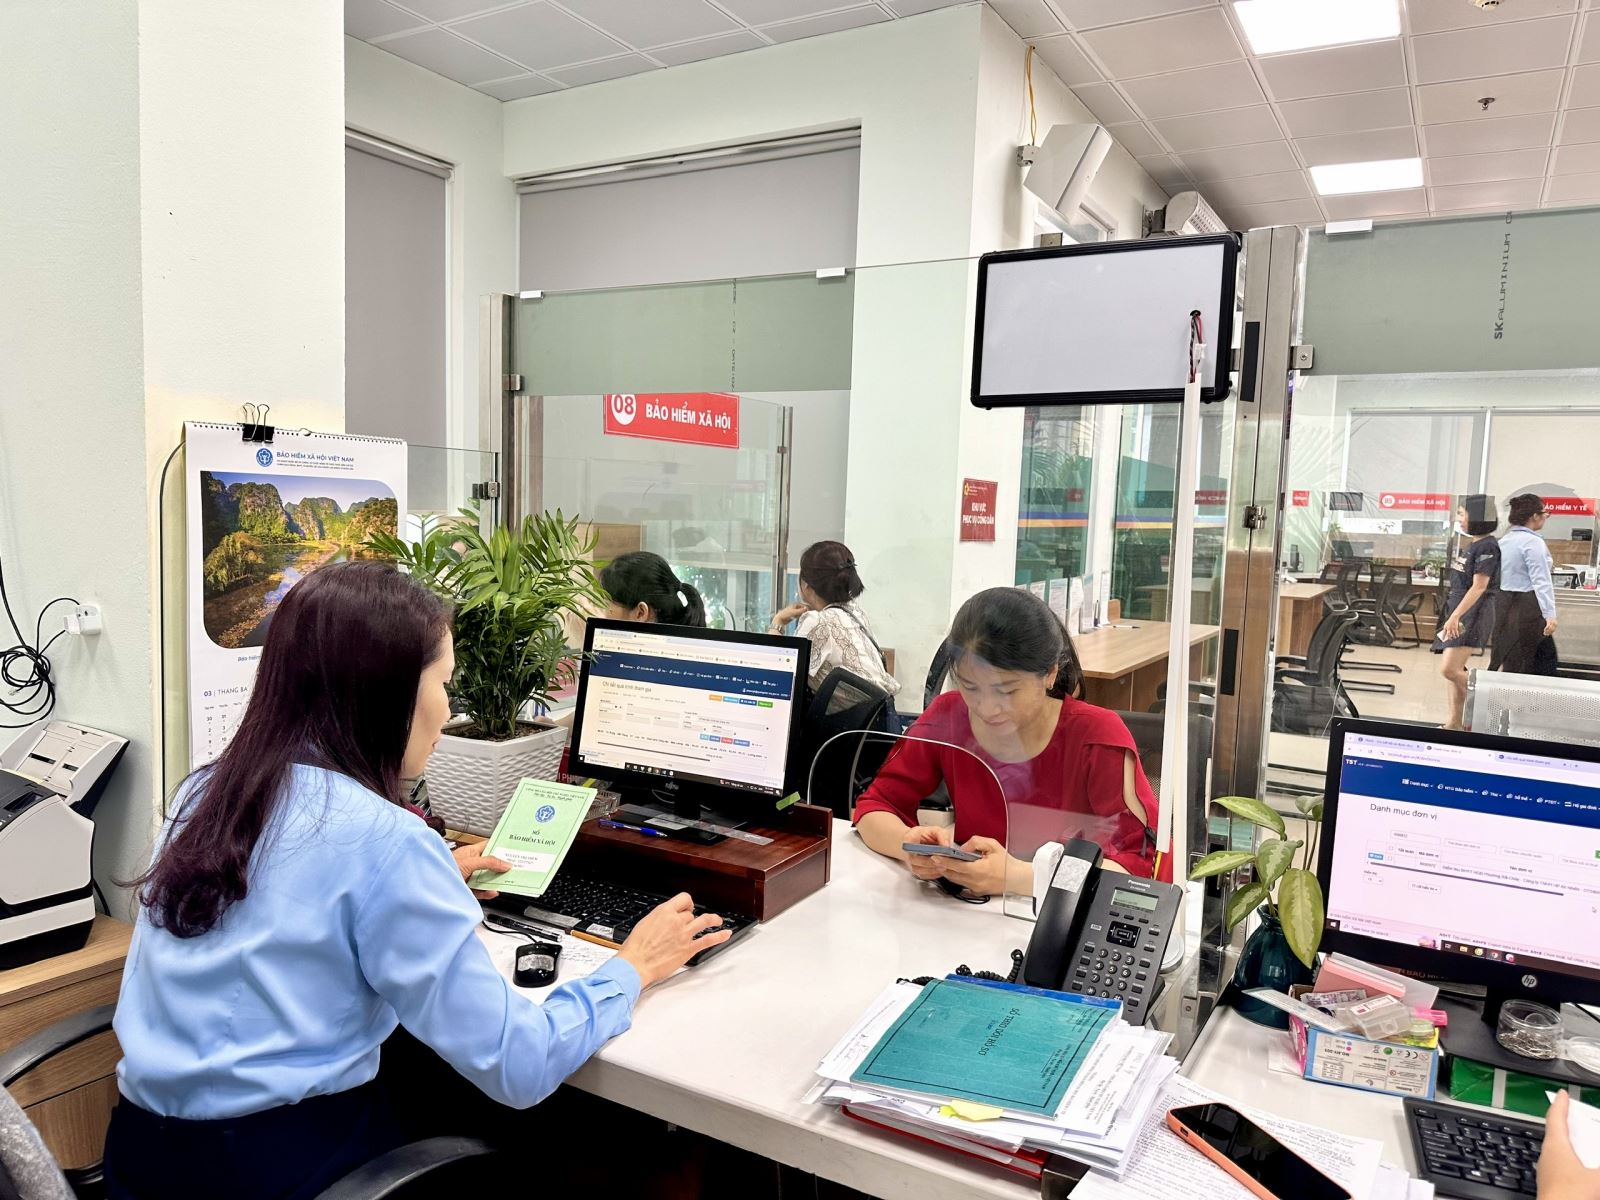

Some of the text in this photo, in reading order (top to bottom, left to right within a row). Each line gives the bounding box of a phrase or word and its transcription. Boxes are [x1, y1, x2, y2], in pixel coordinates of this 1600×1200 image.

[614, 394, 731, 434] 08 BẢO HIỂM XÃ HỘI
[290, 452, 306, 460] HIỂM
[1556, 502, 1572, 511] HIỂM
[1346, 758, 1358, 766] TST
[1370, 803, 1438, 820] Danh mục đơn vị
[1128, 880, 1151, 888] Panasonic
[1524, 976, 1535, 986] hp
